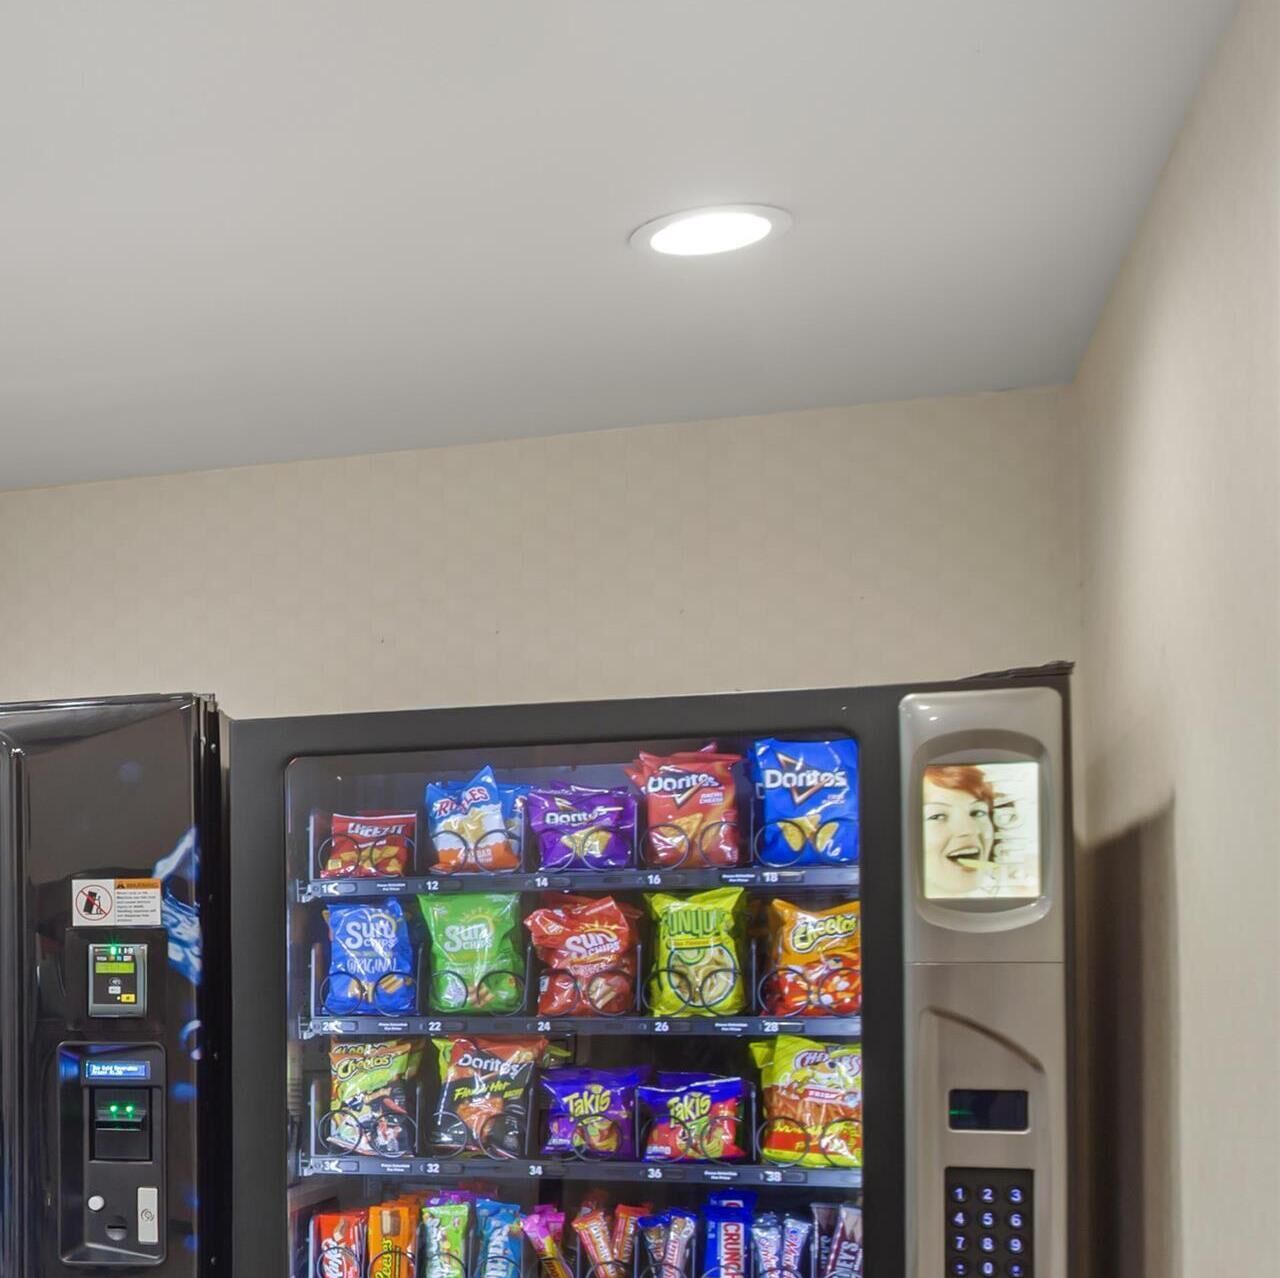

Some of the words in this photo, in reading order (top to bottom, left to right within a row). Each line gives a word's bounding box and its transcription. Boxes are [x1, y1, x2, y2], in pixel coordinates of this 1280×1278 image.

[647, 773, 721, 793] Doritos
[764, 767, 848, 789] Doritos
[426, 881, 438, 890] 12
[535, 877, 548, 888] 14
[647, 874, 661, 885] 16
[428, 1022, 441, 1031] 22
[538, 1022, 551, 1031] 24
[655, 1022, 669, 1032] 26
[764, 1022, 778, 1032] 28
[563, 1086, 611, 1121] Takis
[667, 1092, 712, 1127] Takis
[426, 1163, 439, 1173] 32
[529, 1165, 543, 1176] 34
[647, 1168, 662, 1179] 36
[767, 1171, 782, 1182] 38
[954, 1187, 964, 1200] 1
[983, 1188, 993, 1201] 2
[1011, 1189, 1021, 1202] 3
[954, 1212, 965, 1225] 4
[983, 1213, 993, 1226] 5
[1011, 1214, 1021, 1227] 6
[956, 1236, 965, 1249] 7
[983, 1237, 993, 1250] 8
[1011, 1238, 1022, 1251] 9
[983, 1262, 993, 1274] 0
